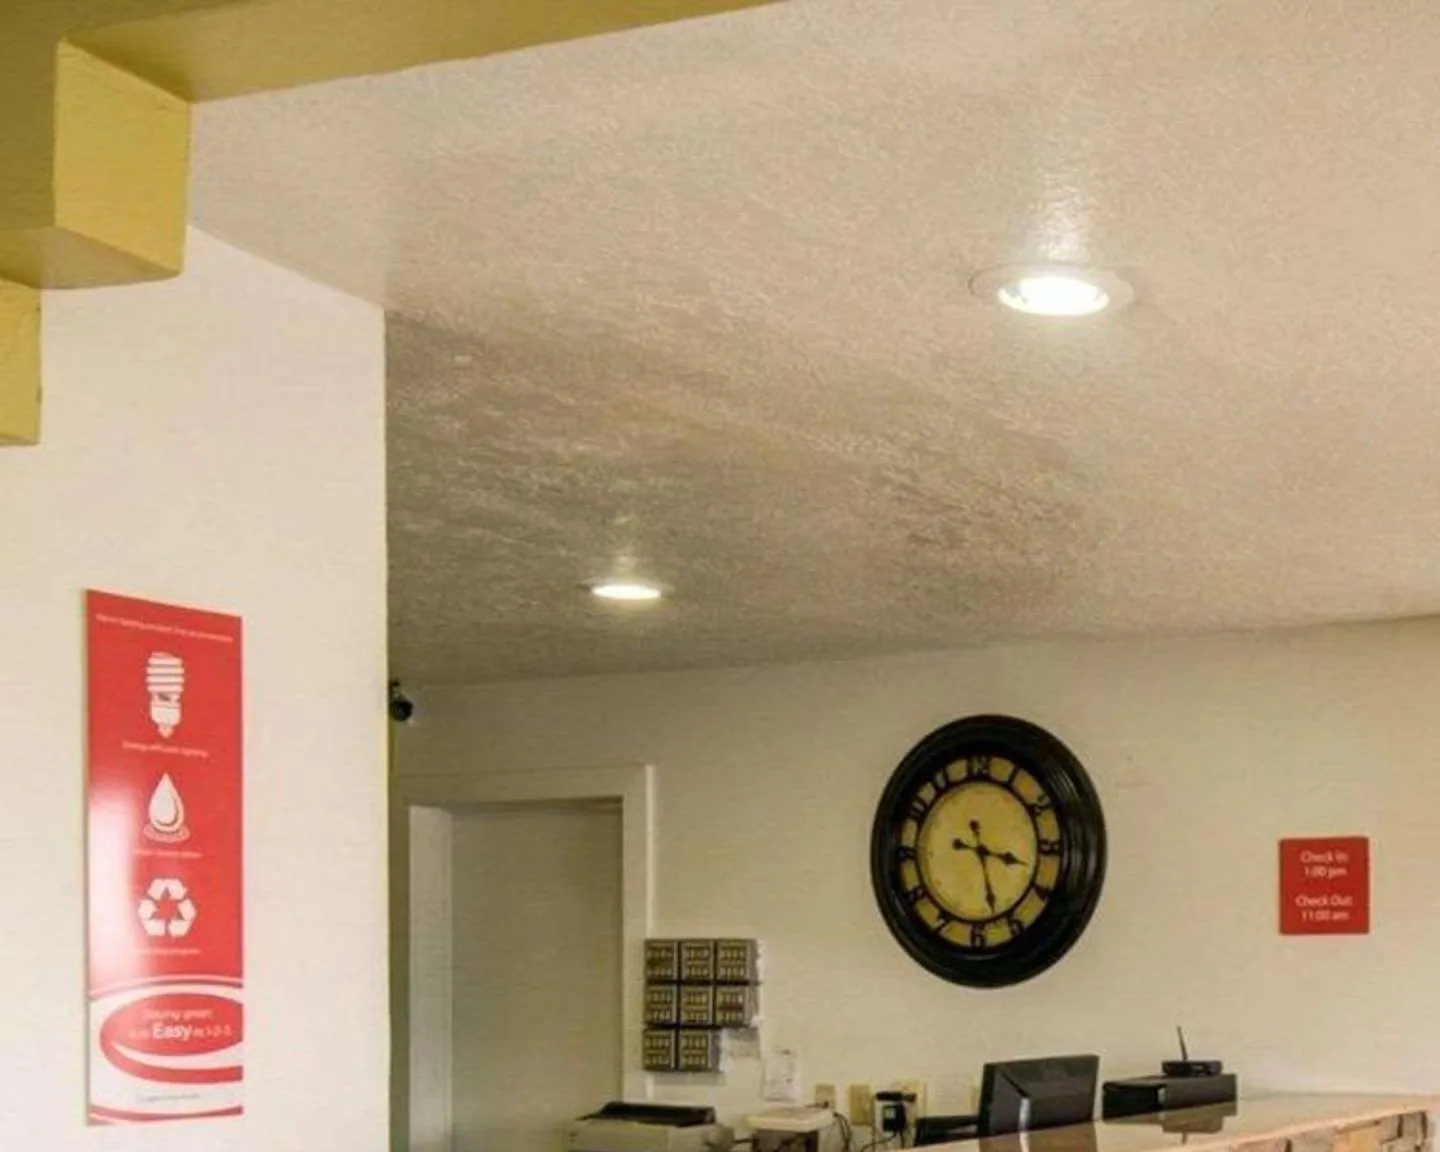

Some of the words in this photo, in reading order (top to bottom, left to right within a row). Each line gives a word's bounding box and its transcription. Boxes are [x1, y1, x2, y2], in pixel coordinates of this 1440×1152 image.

[1300, 849, 1333, 864] Check
[1295, 894, 1328, 907] Check
[152, 1021, 192, 1041] Easy
